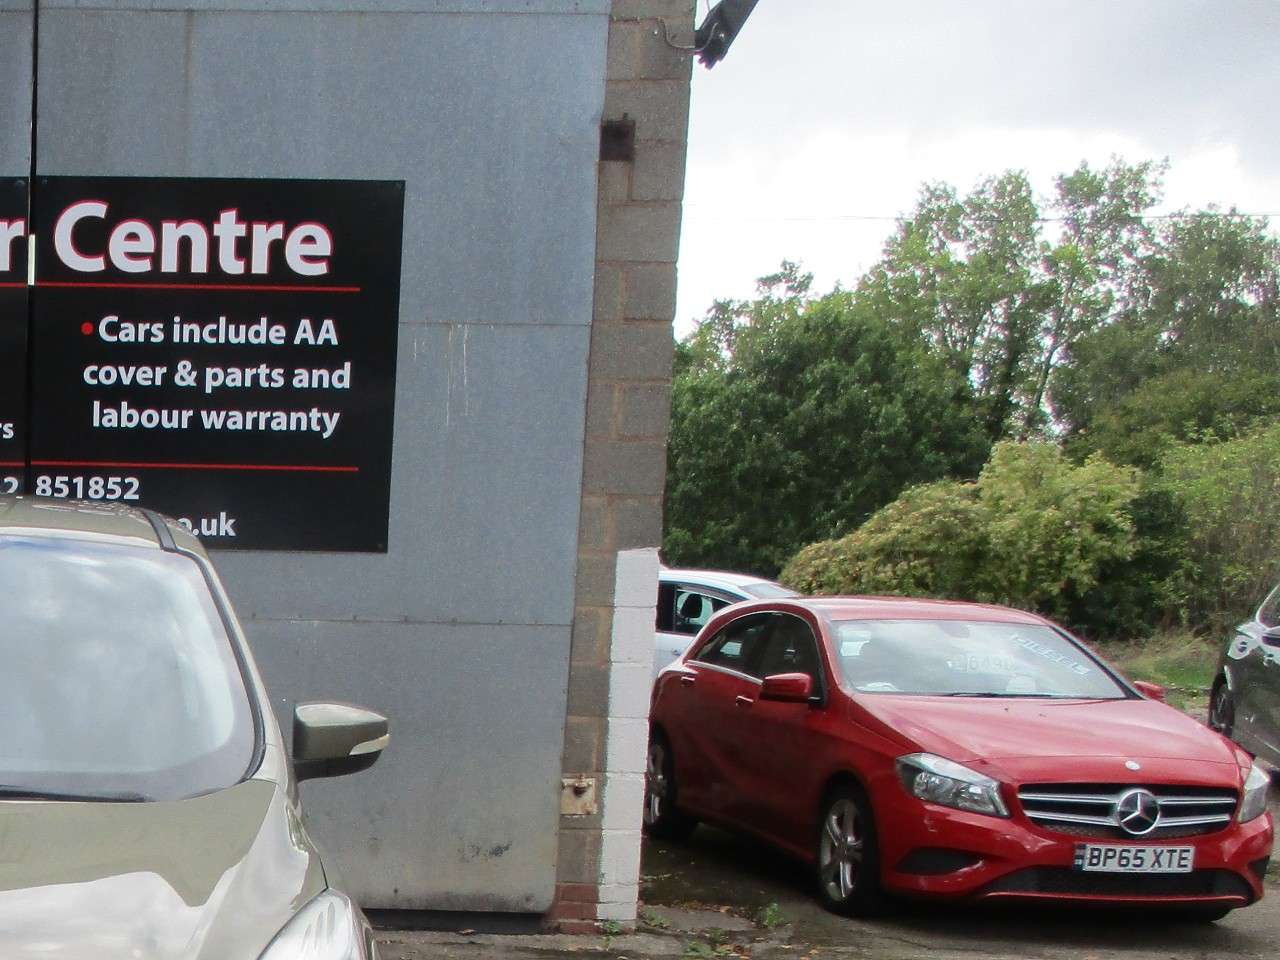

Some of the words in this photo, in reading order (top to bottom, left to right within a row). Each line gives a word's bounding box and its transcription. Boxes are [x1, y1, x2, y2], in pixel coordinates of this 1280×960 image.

[54, 201, 332, 277] Centre
[98, 315, 165, 343] Cars
[172, 316, 287, 345] include
[293, 319, 339, 346] AA
[83, 364, 168, 387] cover
[174, 360, 198, 387] &
[205, 363, 285, 394] parts
[292, 361, 352, 389] and
[92, 400, 194, 430] labour
[200, 407, 341, 439] warranty
[35, 475, 140, 500] 851852
[1087, 847, 1145, 868] BP65
[1150, 848, 1192, 869] XTE
